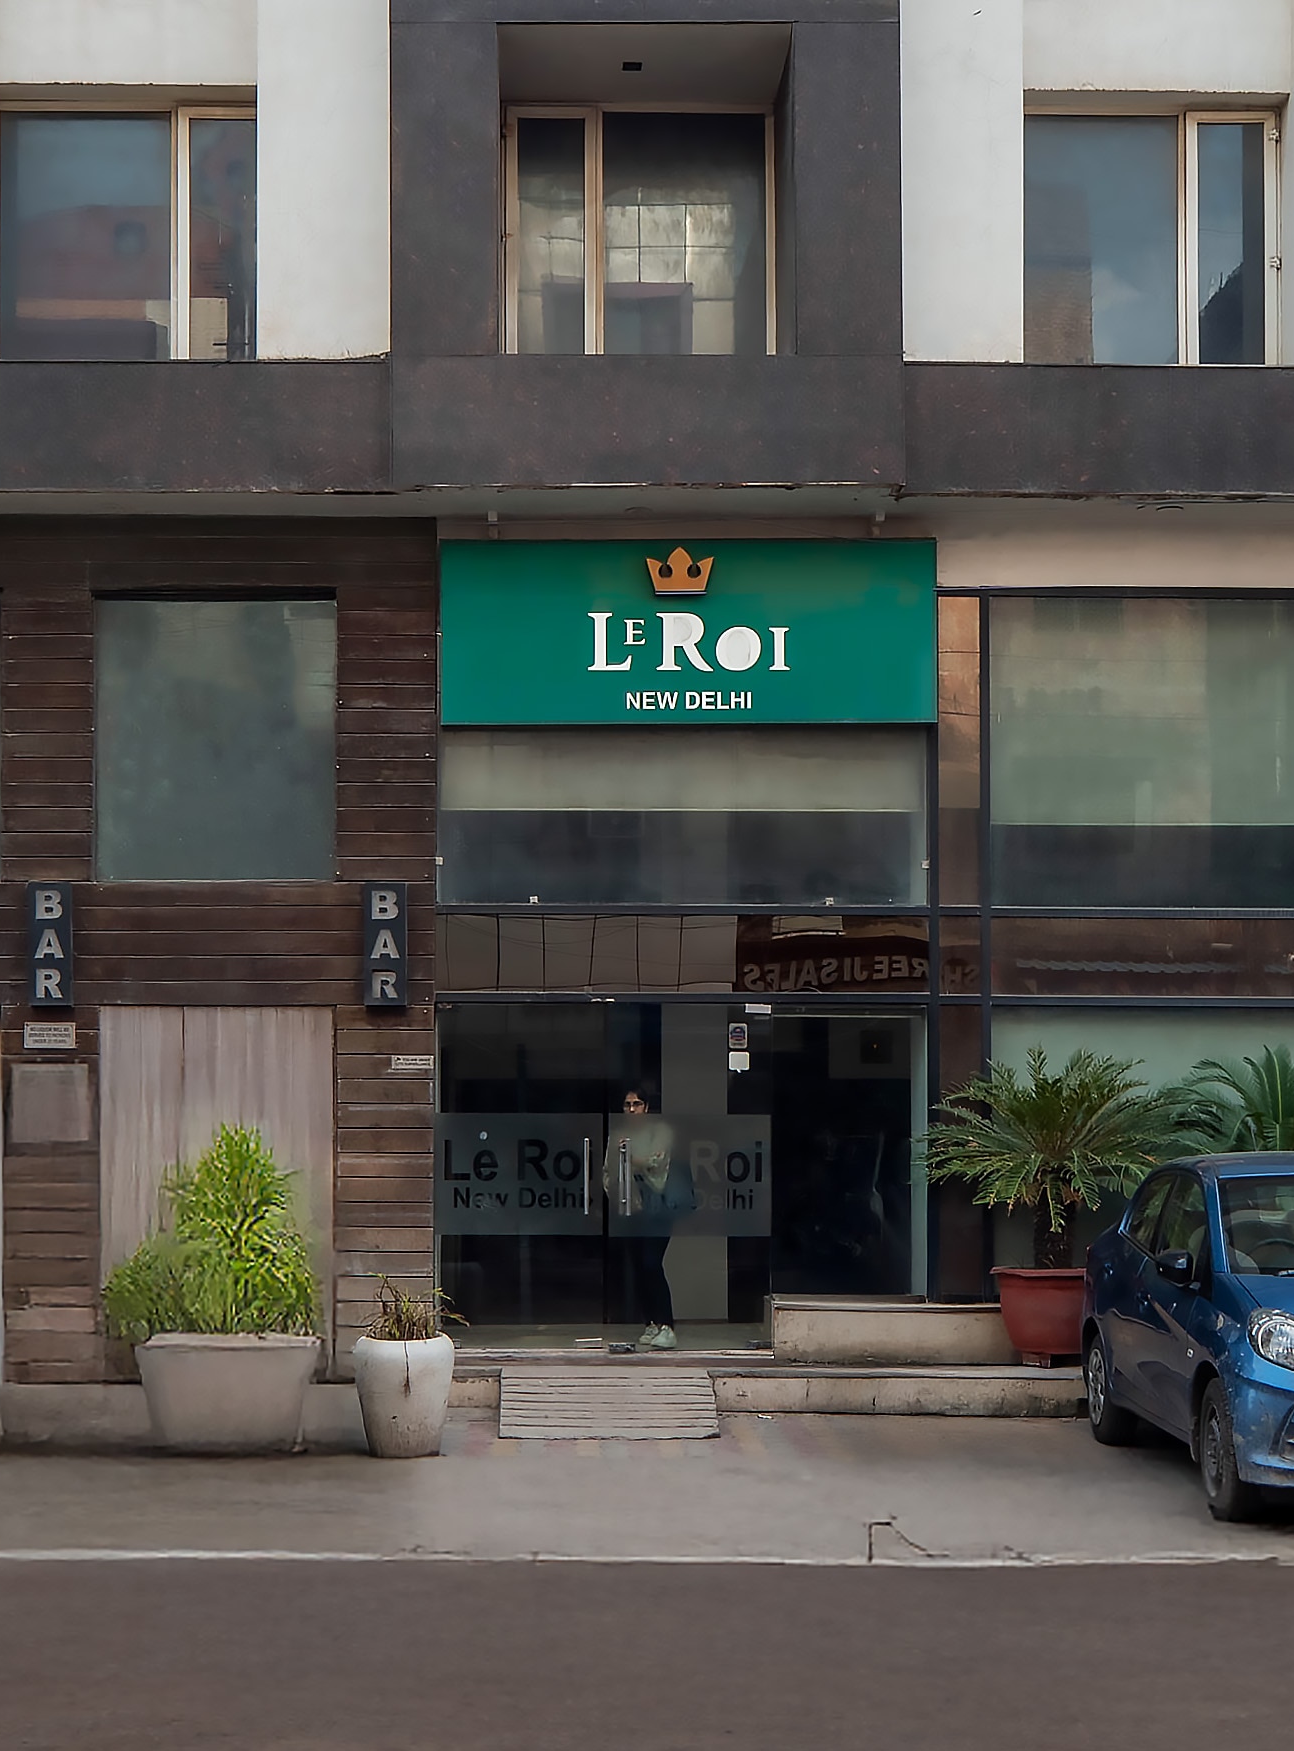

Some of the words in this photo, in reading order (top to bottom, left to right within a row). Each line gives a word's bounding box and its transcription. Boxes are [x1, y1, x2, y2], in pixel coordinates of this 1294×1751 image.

[625, 691, 679, 710] NEW
[685, 691, 753, 710] DELHI
[33, 889, 66, 1000] BAR
[370, 889, 401, 1000] BAR
[443, 1139, 499, 1182] Le
